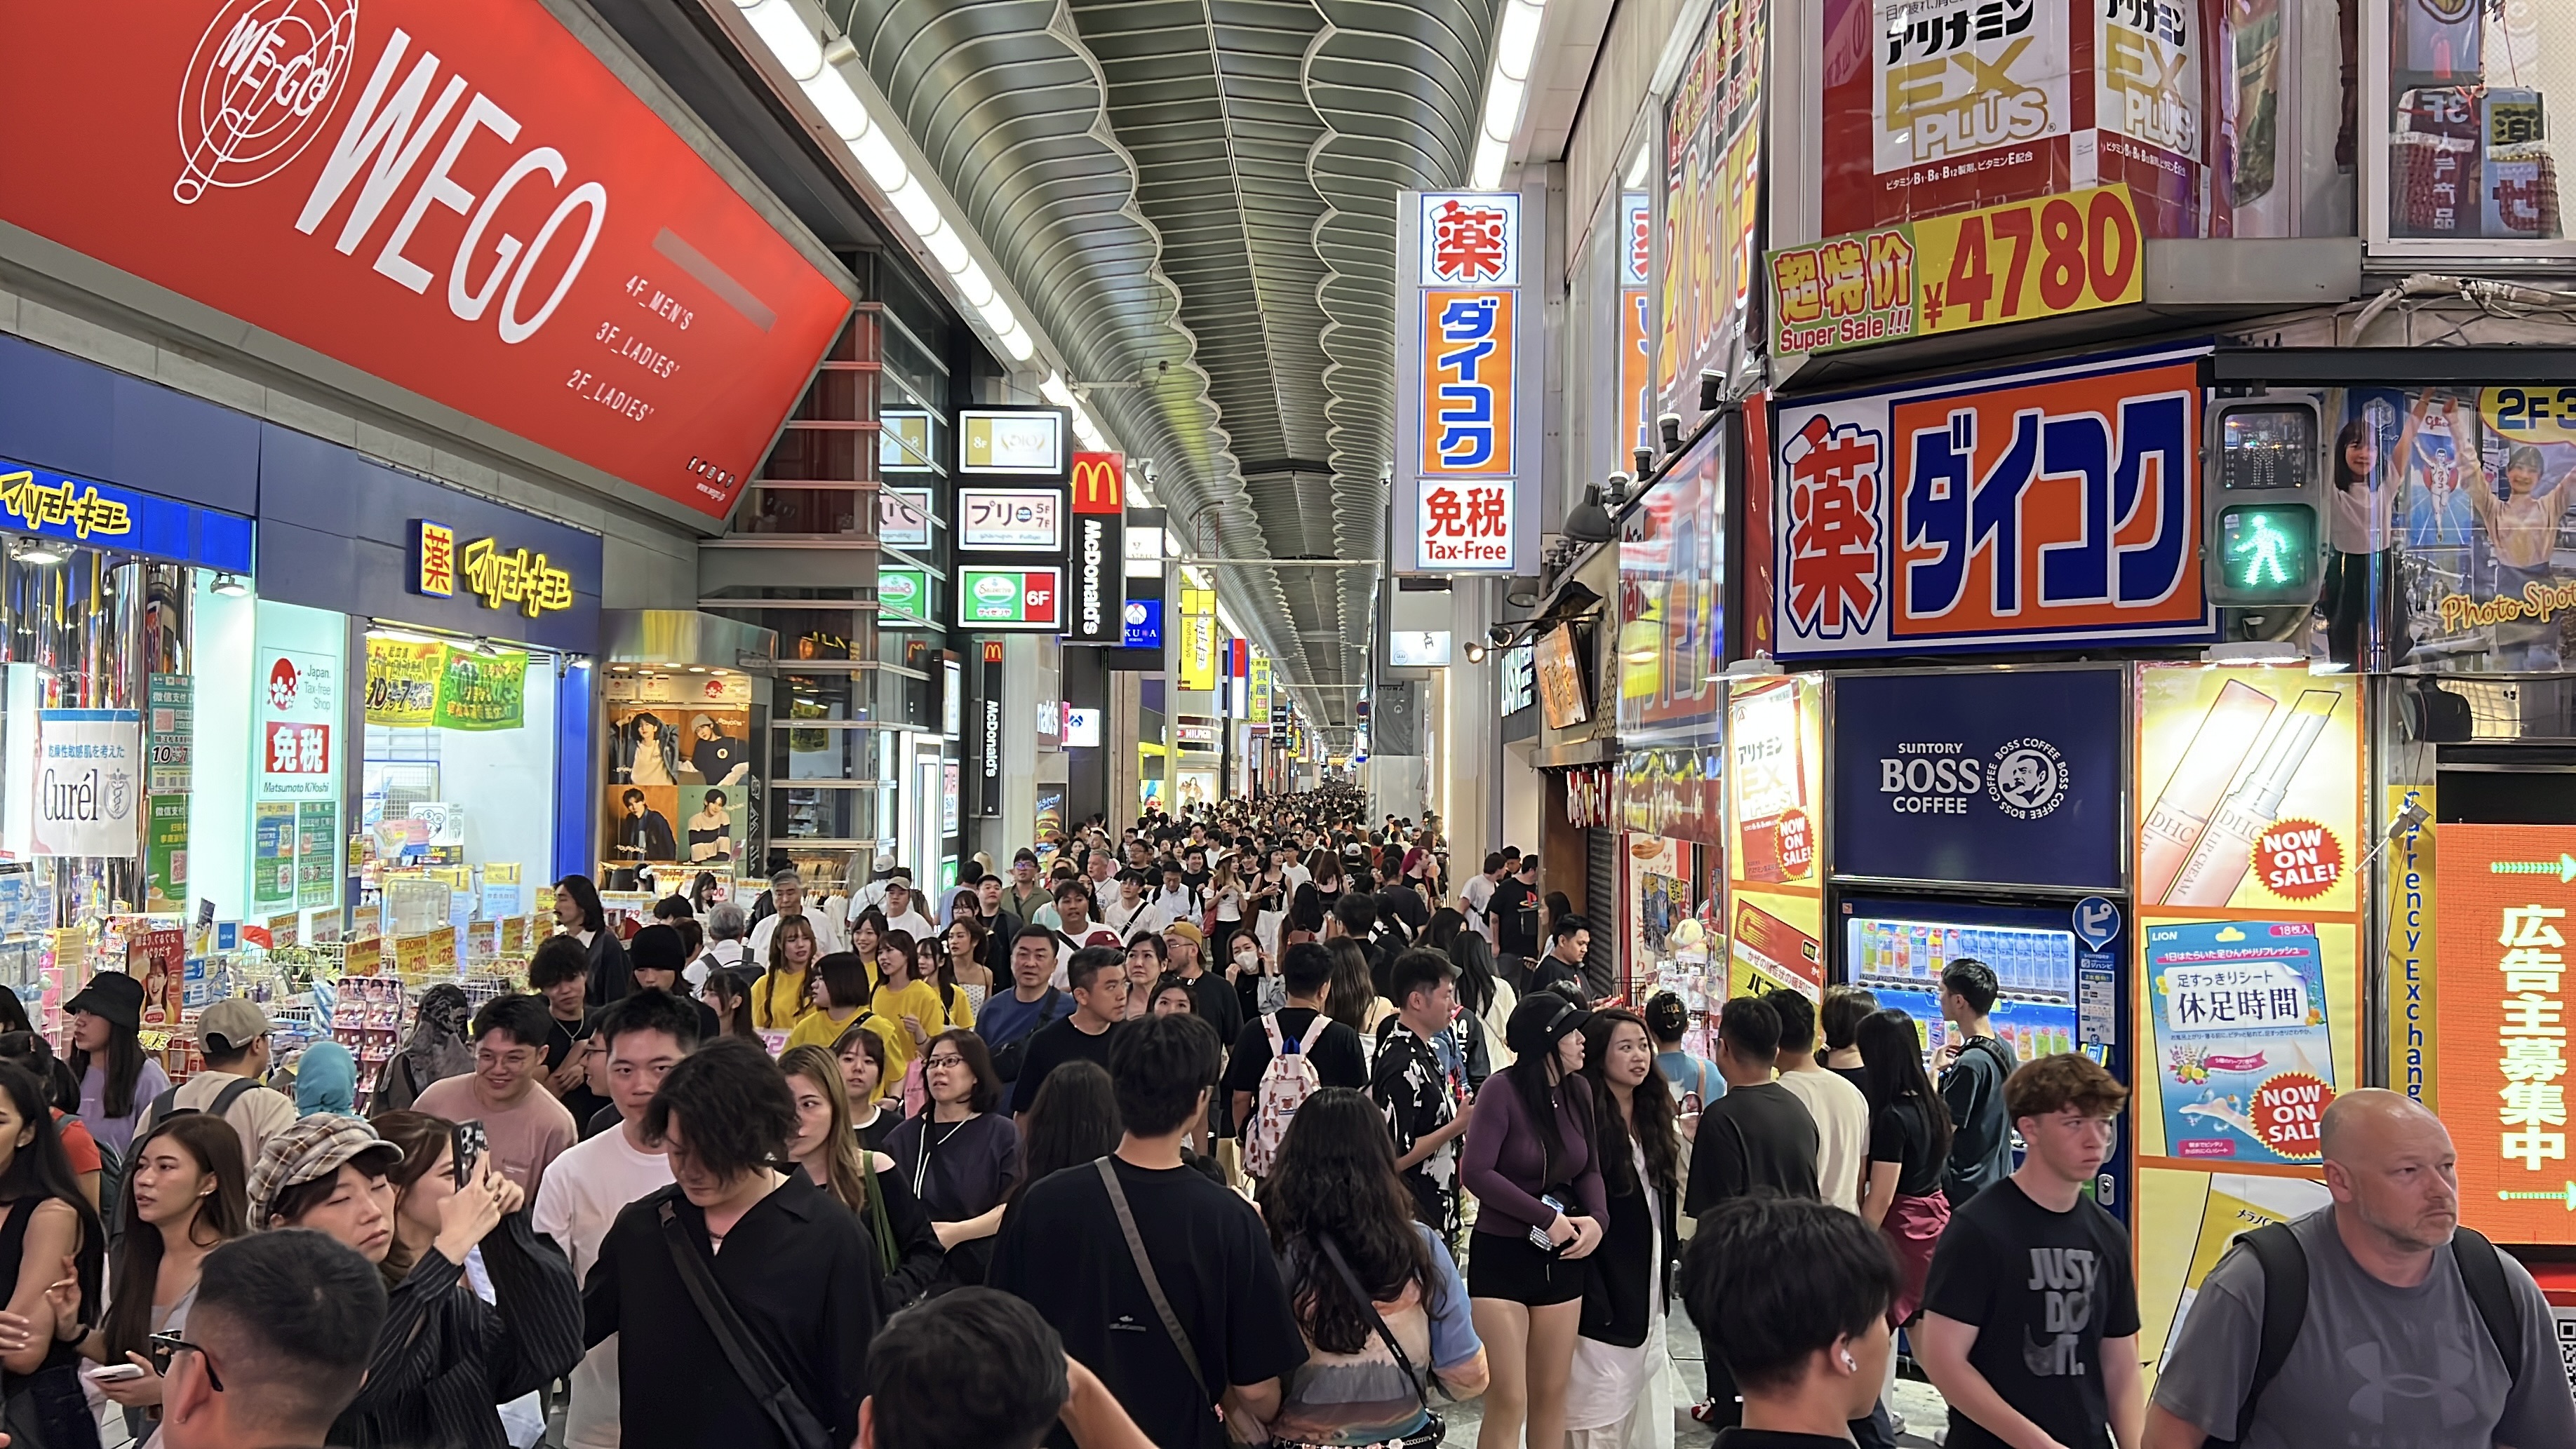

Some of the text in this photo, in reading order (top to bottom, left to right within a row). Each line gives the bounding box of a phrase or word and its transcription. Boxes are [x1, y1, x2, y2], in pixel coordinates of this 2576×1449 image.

[1886, 0, 2034, 65] アリナミン
[218, 13, 328, 116] WEGO
[2107, 22, 2187, 93] EX
[1886, 35, 2034, 132] EX
[1912, 87, 2048, 162] PLUS
[2124, 87, 2194, 154] PLUS
[295, 27, 607, 344] WEGO
[1433, 200, 1506, 281] 薬
[1780, 320, 1837, 353] Super
[1839, 314, 1885, 342] Sale
[1437, 295, 1500, 469] ダイコク
[2497, 388, 2549, 430] 2F
[973, 436, 988, 449] 8F
[971, 499, 1013, 527] プリ
[1035, 504, 1050, 514] 5F
[1035, 518, 1050, 528] 7F
[1426, 486, 1507, 538] 免税
[1901, 390, 2190, 620] ダイコク
[1784, 414, 1881, 638] 薬
[424, 528, 450, 591] 薬
[1425, 540, 1507, 560] Tax-Free
[1083, 519, 1101, 635] McDonald's
[1026, 590, 1050, 607] 6F
[2441, 593, 2525, 633] Photo
[304, 682, 331, 695] Tax-free
[314, 697, 330, 713] Shop
[272, 727, 323, 772] 免税
[986, 700, 999, 778] McDonald's
[1738, 736, 1783, 765] アリナミン
[264, 781, 304, 794] Matsumoto
[1880, 758, 1981, 794] BOSS
[1986, 738, 2069, 819] BOSS COFFEE BOSS COFFEE BOSS COFFEE
[43, 767, 99, 823] Curél
[1893, 796, 1967, 814] COFFEE
[1780, 815, 1806, 837] NOW
[1784, 830, 1804, 849] ON
[2149, 810, 2194, 843] DHC
[2218, 809, 2265, 842] DHC
[2263, 828, 2323, 854] NOW
[1782, 845, 1812, 867] SALE!
[2177, 831, 2222, 896] LIP CREAM
[2273, 849, 2318, 869] ON
[2269, 863, 2337, 888] SALE!
[2082, 903, 2113, 937] ピ
[2152, 931, 2178, 941] LION
[2279, 924, 2312, 935] 18枚入
[2178, 969, 2274, 988] 足すっきりシート
[2178, 987, 2300, 1024] 休足時間
[137, 1030, 172, 1051] 限定
[2406, 959, 2423, 1107] Exchang
[2498, 903, 2568, 1172] 広告主募集中
[2261, 1084, 2321, 1108] NOW
[2272, 1103, 2317, 1123] ON
[2237, 1209, 2273, 1227] メラノC
[2027, 1248, 2095, 1290] JUST
[2045, 1290, 2091, 1333] DO
